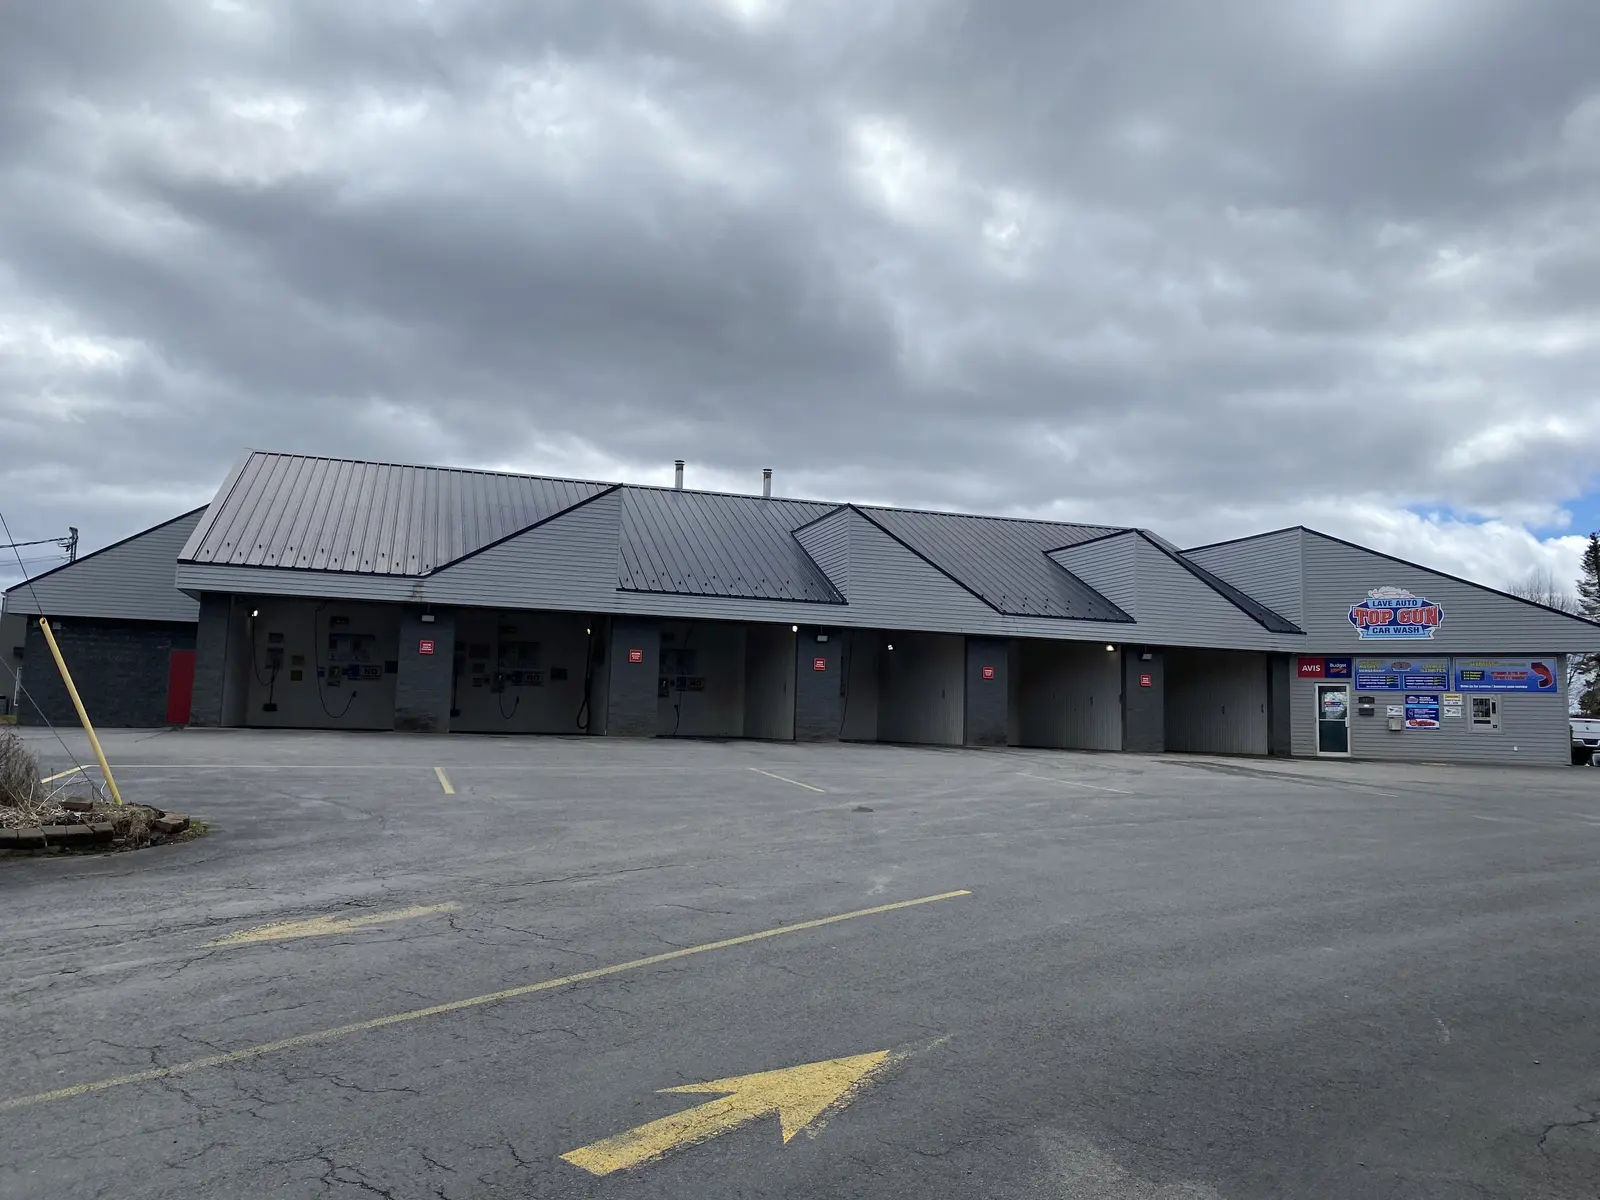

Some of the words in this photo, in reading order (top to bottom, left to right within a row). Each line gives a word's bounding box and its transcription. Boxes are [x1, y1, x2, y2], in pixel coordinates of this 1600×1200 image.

[1395, 599, 1418, 607] AUTO
[1353, 608, 1394, 627] TOP
[1397, 607, 1439, 627] GUN
[1393, 626, 1420, 634] WASH
[1301, 664, 1321, 672] AVIS
